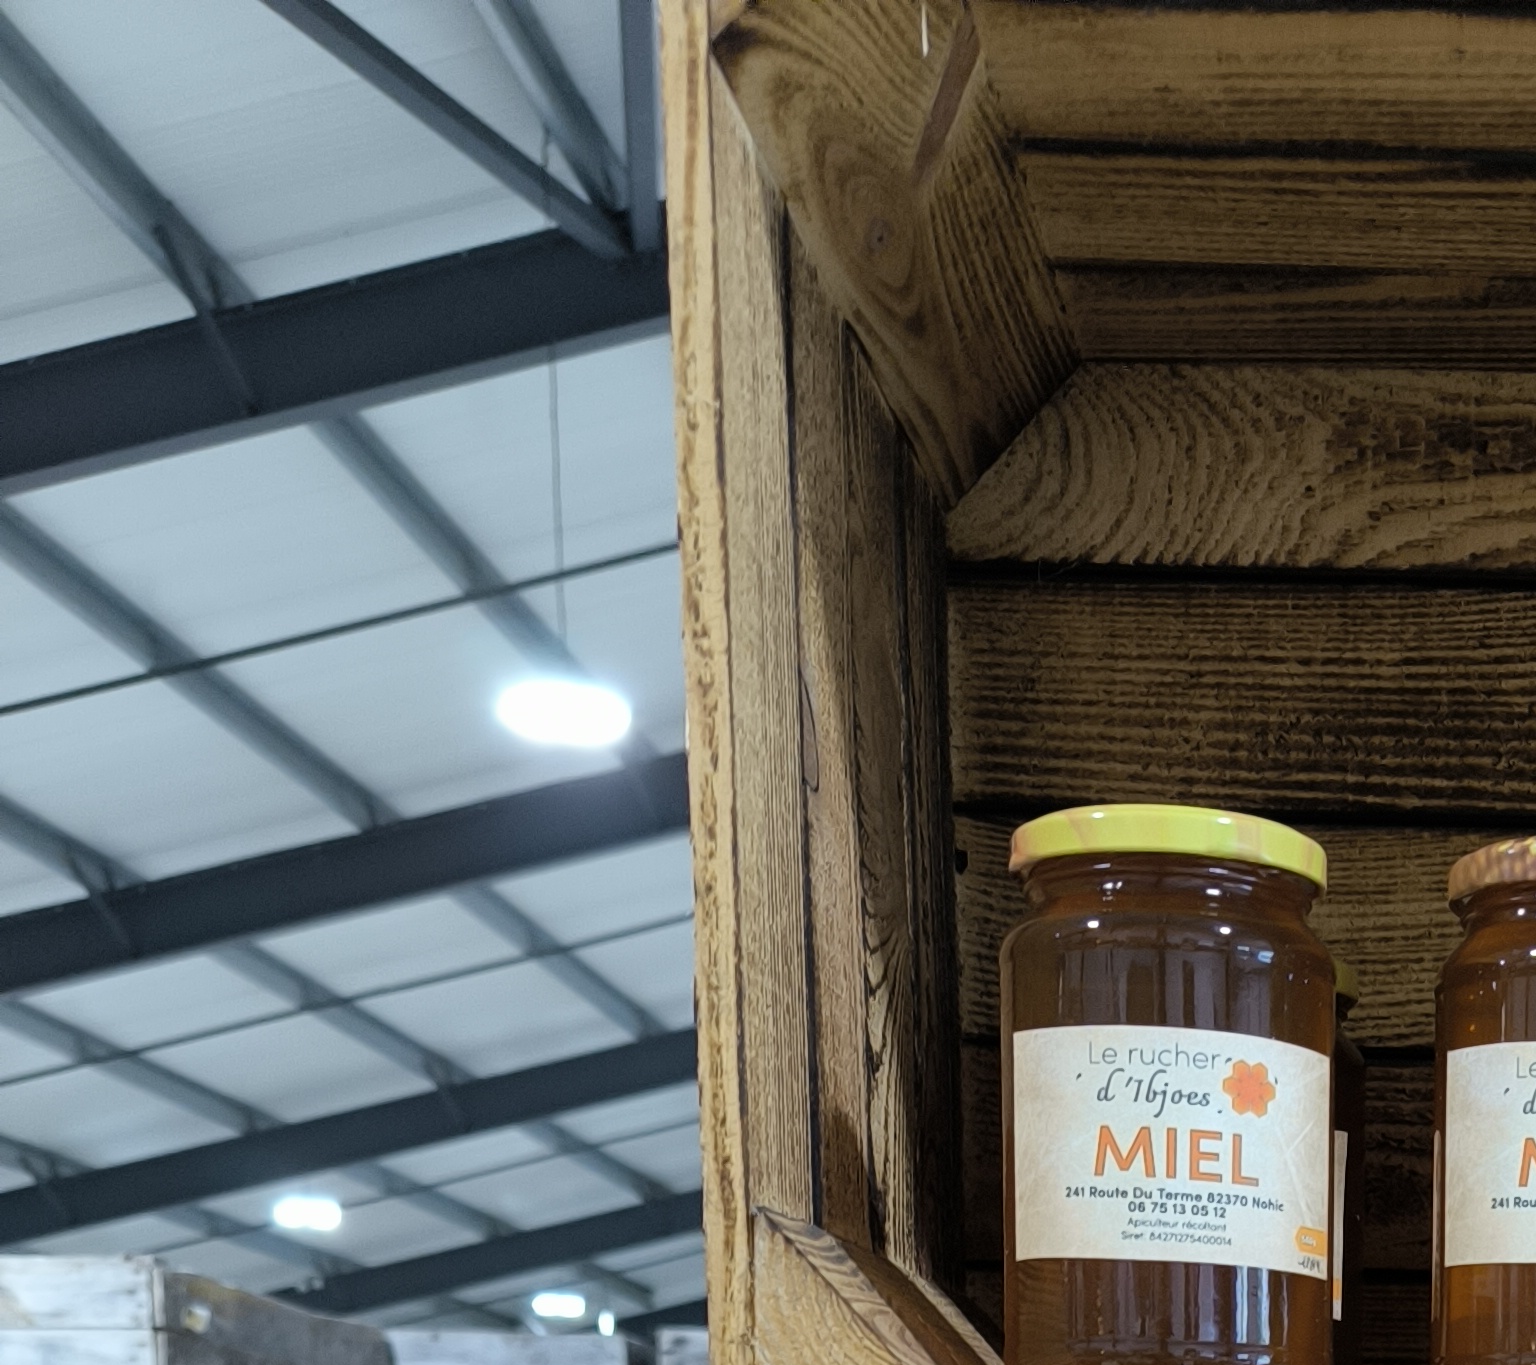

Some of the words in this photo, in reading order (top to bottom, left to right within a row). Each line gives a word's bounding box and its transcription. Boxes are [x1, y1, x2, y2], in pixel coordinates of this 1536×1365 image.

[1088, 1041, 1118, 1065] Le
[1128, 1043, 1220, 1069] rucher
[1094, 1125, 1259, 1187] MIEL
[1065, 1186, 1085, 1198] 241
[1089, 1186, 1128, 1199] Route
[1133, 1187, 1153, 1199] Du
[1157, 1188, 1202, 1202] Terme
[1207, 1192, 1248, 1206] 82370
[1252, 1197, 1284, 1211] Nohic
[1128, 1201, 1145, 1212] 06
[1151, 1202, 1168, 1213] 75
[1172, 1203, 1186, 1214] 13
[1191, 1204, 1209, 1217] 05
[1213, 1207, 1227, 1218] 12
[1491, 1197, 1510, 1209] 241
